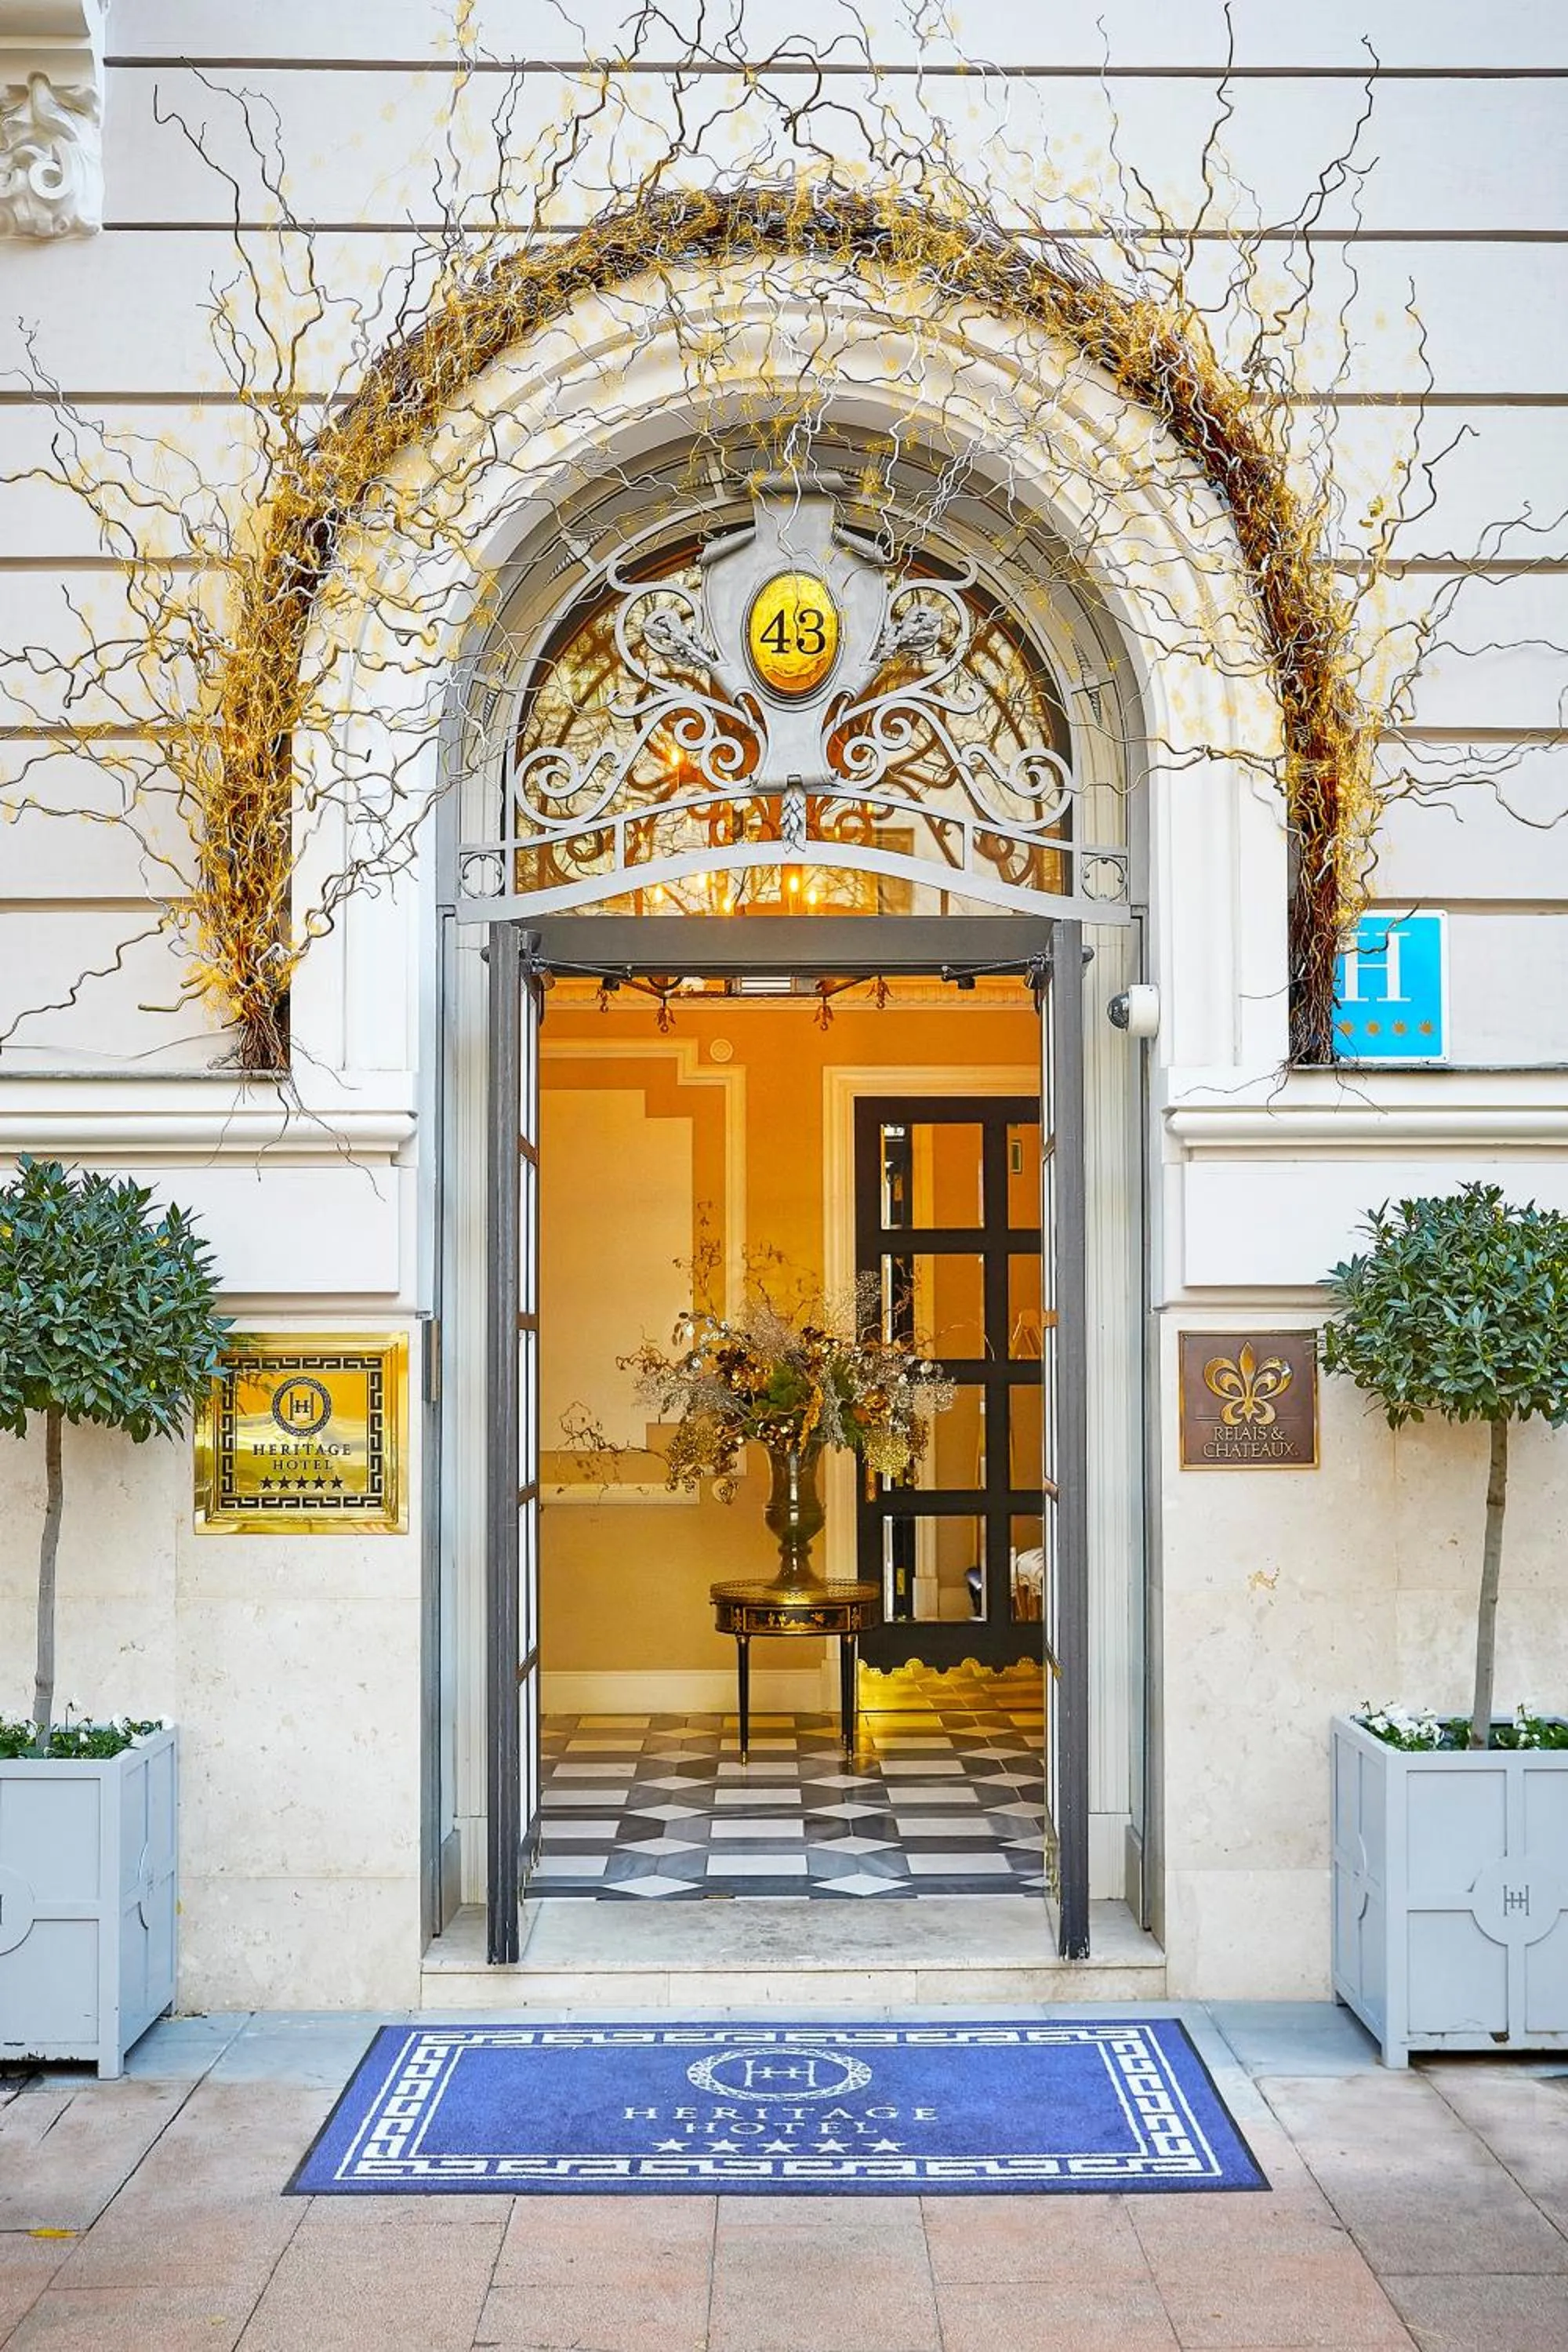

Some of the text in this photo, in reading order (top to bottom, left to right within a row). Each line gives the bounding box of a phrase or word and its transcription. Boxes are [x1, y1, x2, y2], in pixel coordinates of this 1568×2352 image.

[760, 608, 826, 655] 43
[1338, 931, 1411, 1002] H
[1214, 1426, 1285, 1441] RELAIS &
[252, 1443, 352, 1456] HERITAGE
[273, 1459, 334, 1471] HOTEL
[622, 2106, 940, 2121] HERITAGE
[684, 2122, 879, 2135] HOTEL
